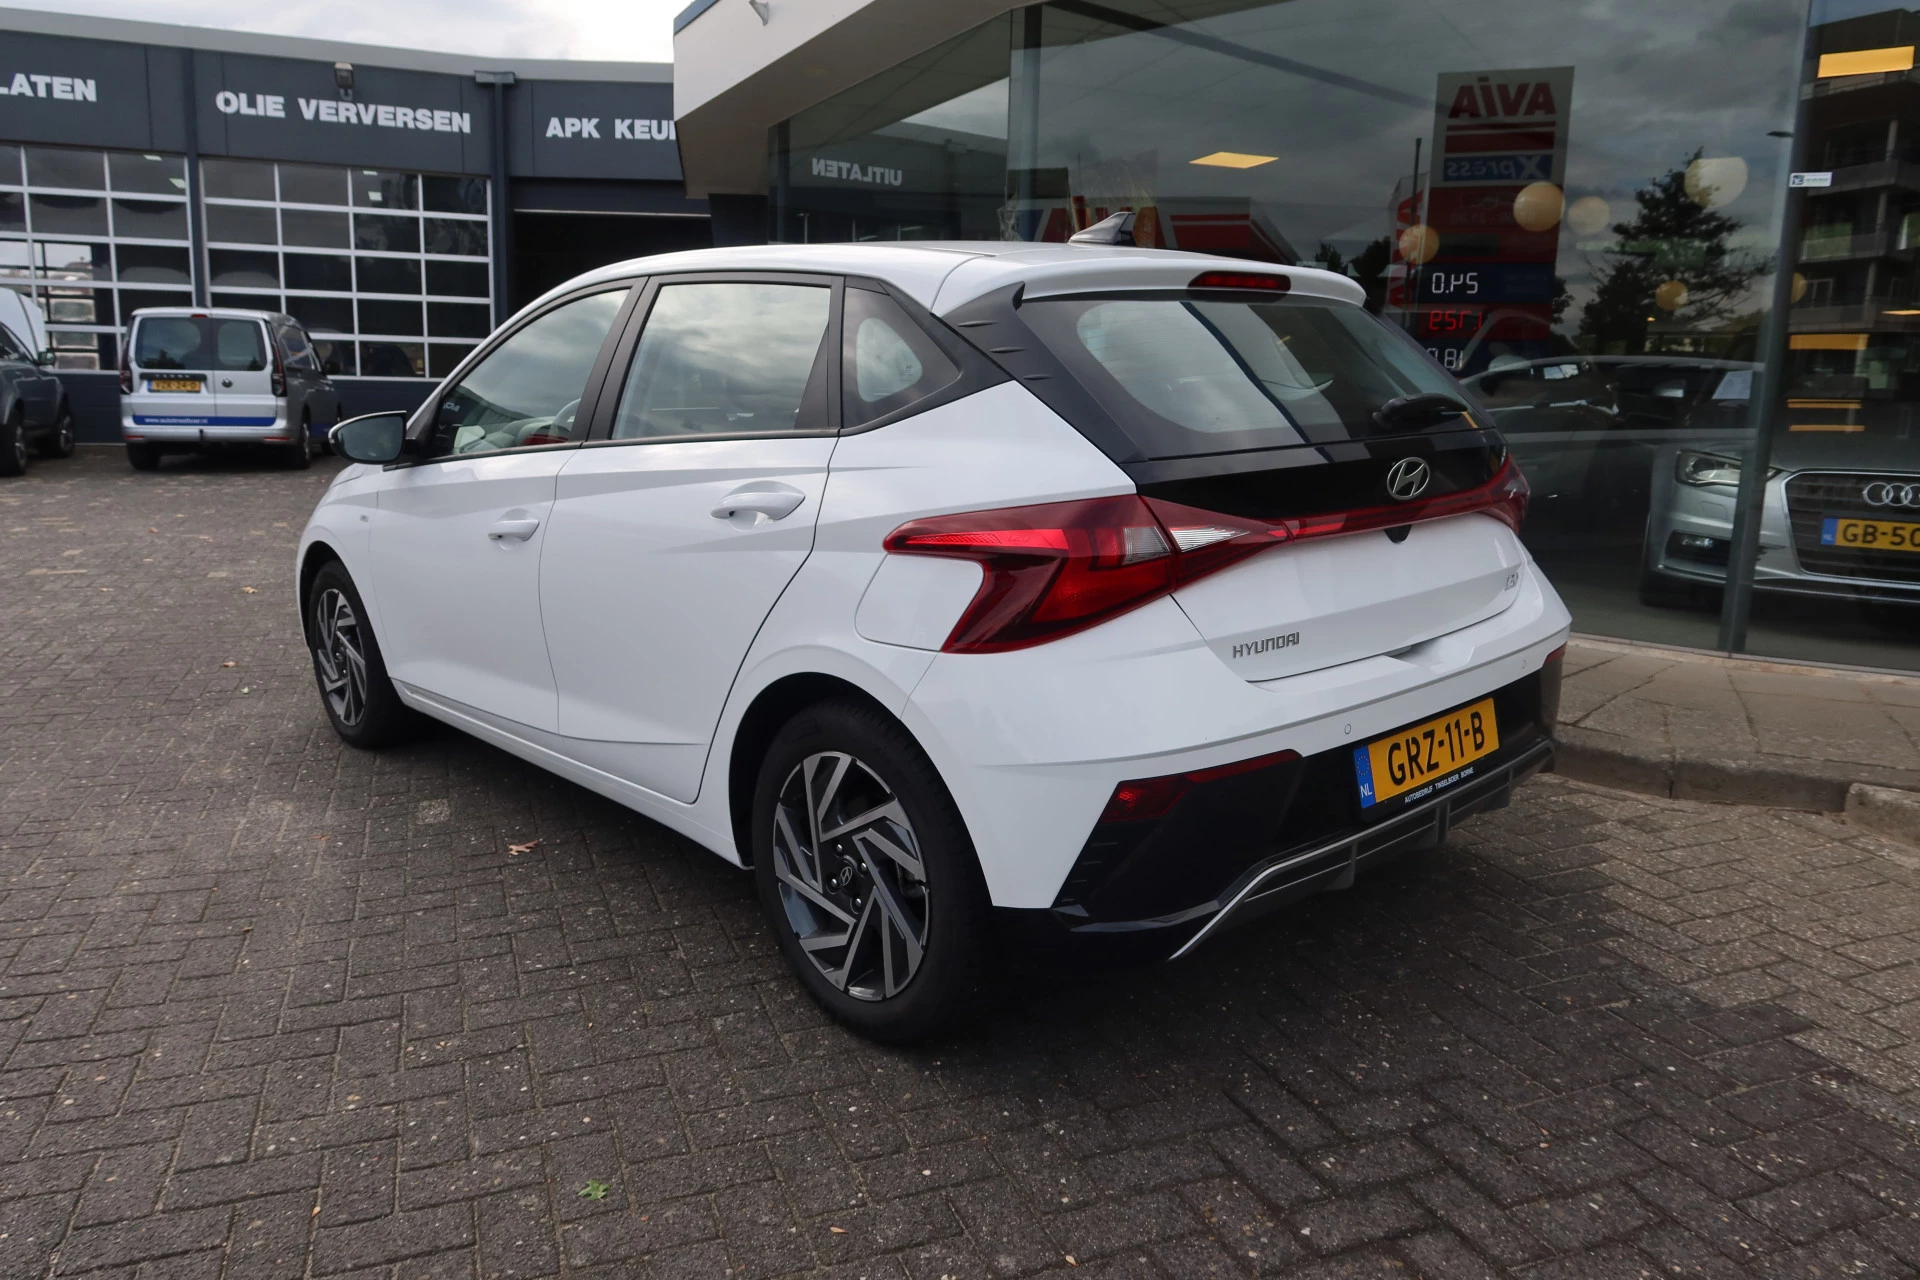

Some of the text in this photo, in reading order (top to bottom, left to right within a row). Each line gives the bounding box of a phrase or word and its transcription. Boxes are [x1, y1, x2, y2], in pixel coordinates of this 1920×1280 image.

[215, 91, 471, 133] OLIE VERVERSEN
[545, 117, 601, 138] APK
[1233, 632, 1300, 659] HYUNDAI
[1388, 711, 1485, 786] GRZ-11-B
[1360, 783, 1372, 798] NL
[1405, 785, 1433, 803] AUTOBEDRIJF
[1461, 767, 1474, 779] BORNE
